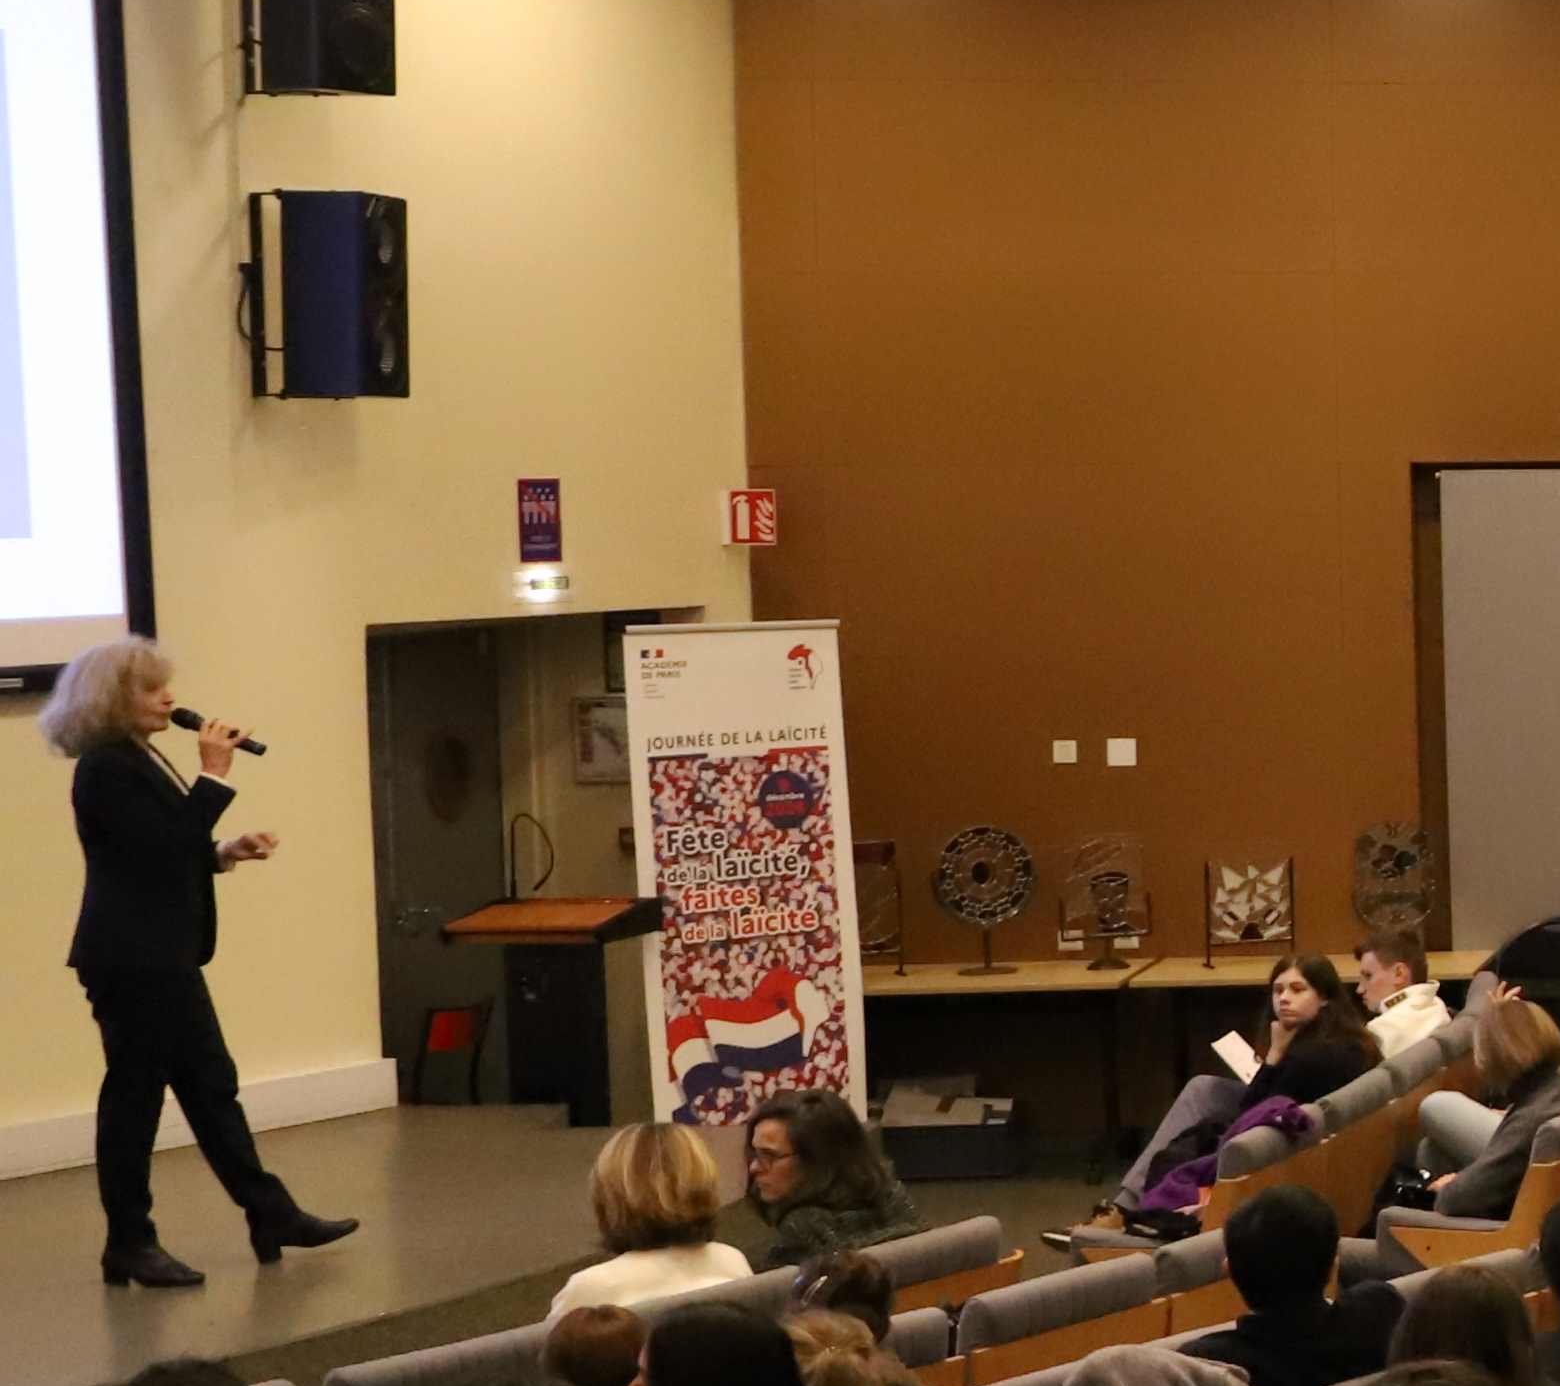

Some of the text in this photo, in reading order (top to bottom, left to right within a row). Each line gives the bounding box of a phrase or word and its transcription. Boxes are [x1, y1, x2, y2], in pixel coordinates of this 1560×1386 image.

[647, 725, 828, 752] JOURNÉE DE LA LAÏCITÉ
[667, 827, 726, 854] Fête
[667, 846, 809, 883] de la laïcité,
[682, 885, 759, 911] faites
[684, 902, 818, 941] de la laïcité
